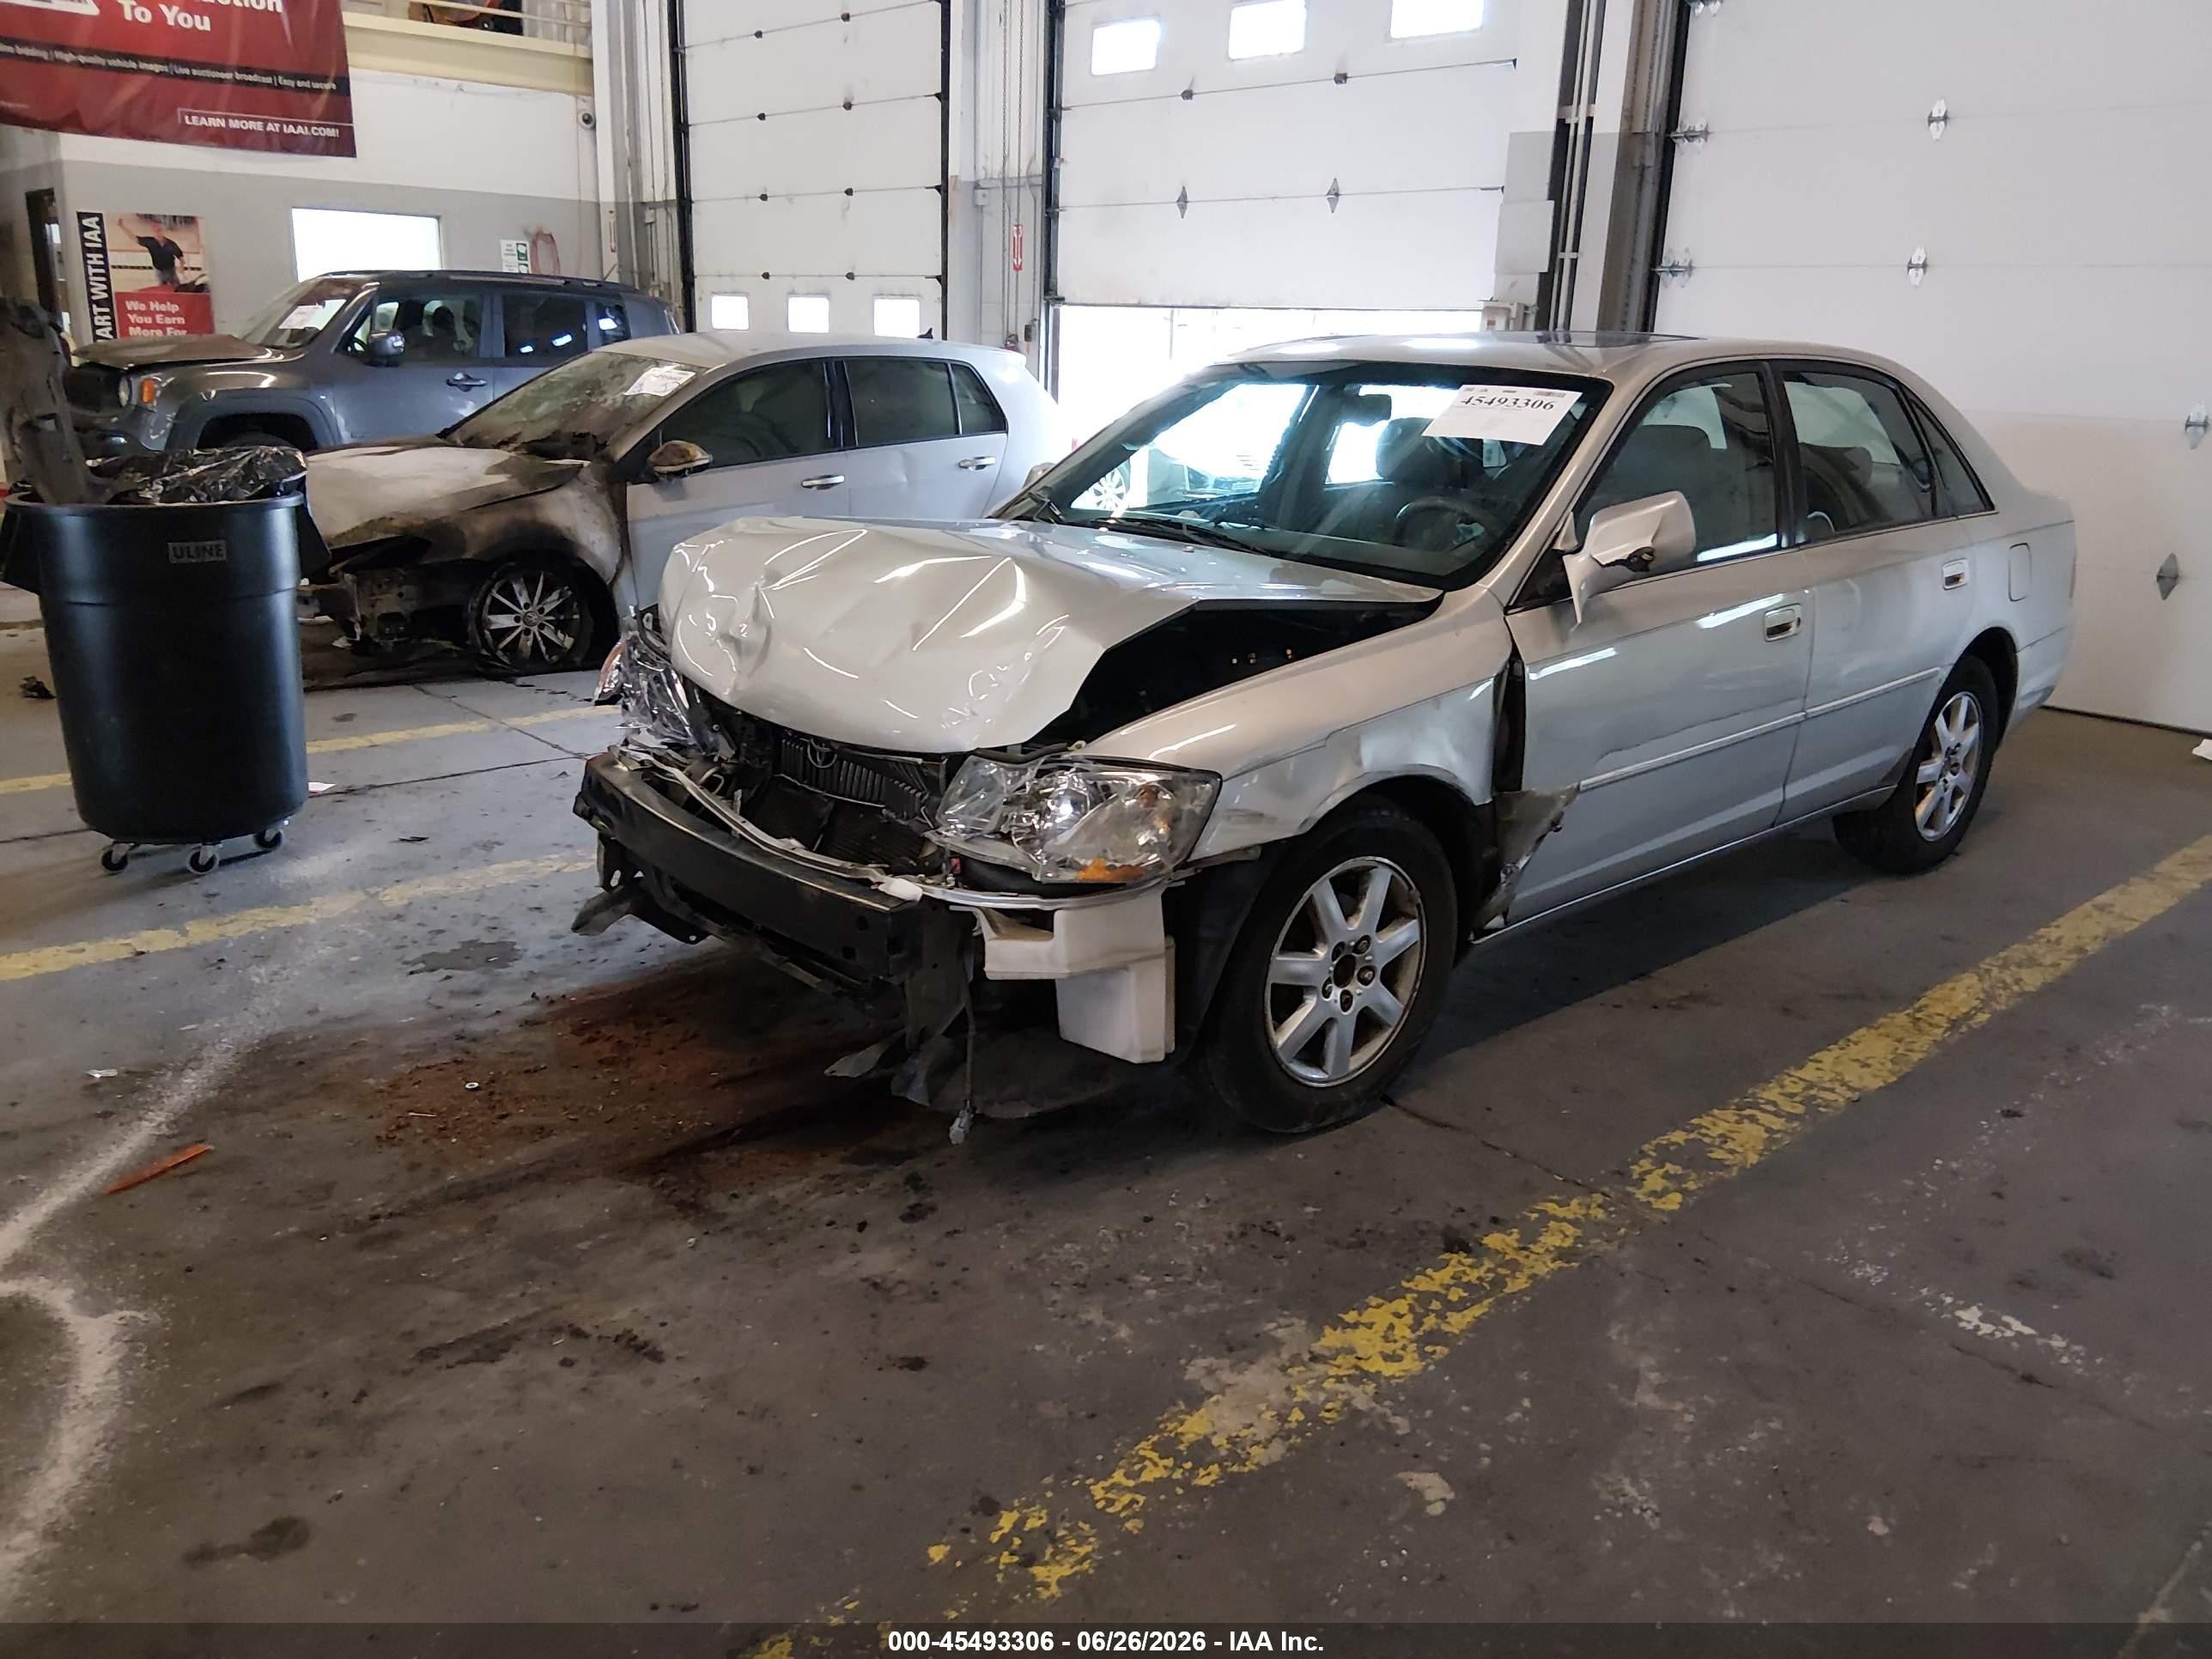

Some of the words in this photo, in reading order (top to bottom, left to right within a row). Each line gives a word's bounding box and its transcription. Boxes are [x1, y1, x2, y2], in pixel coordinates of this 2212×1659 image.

[117, 0, 152, 23] To
[159, 3, 210, 32] You
[185, 115, 225, 128] LEARN
[228, 118, 264, 131] MORE
[266, 123, 280, 132] AT
[283, 125, 339, 137] IAAI.COM!
[82, 216, 102, 247] IAA
[88, 253, 108, 301] WITH
[125, 301, 146, 311] We
[149, 301, 179, 313] Help
[92, 304, 113, 342] ART
[127, 314, 152, 325] You
[155, 314, 185, 325] Earn
[129, 327, 163, 337] More
[167, 327, 187, 337] For
[1461, 396, 1556, 410] 45493306
[173, 544, 224, 559] ULINE
